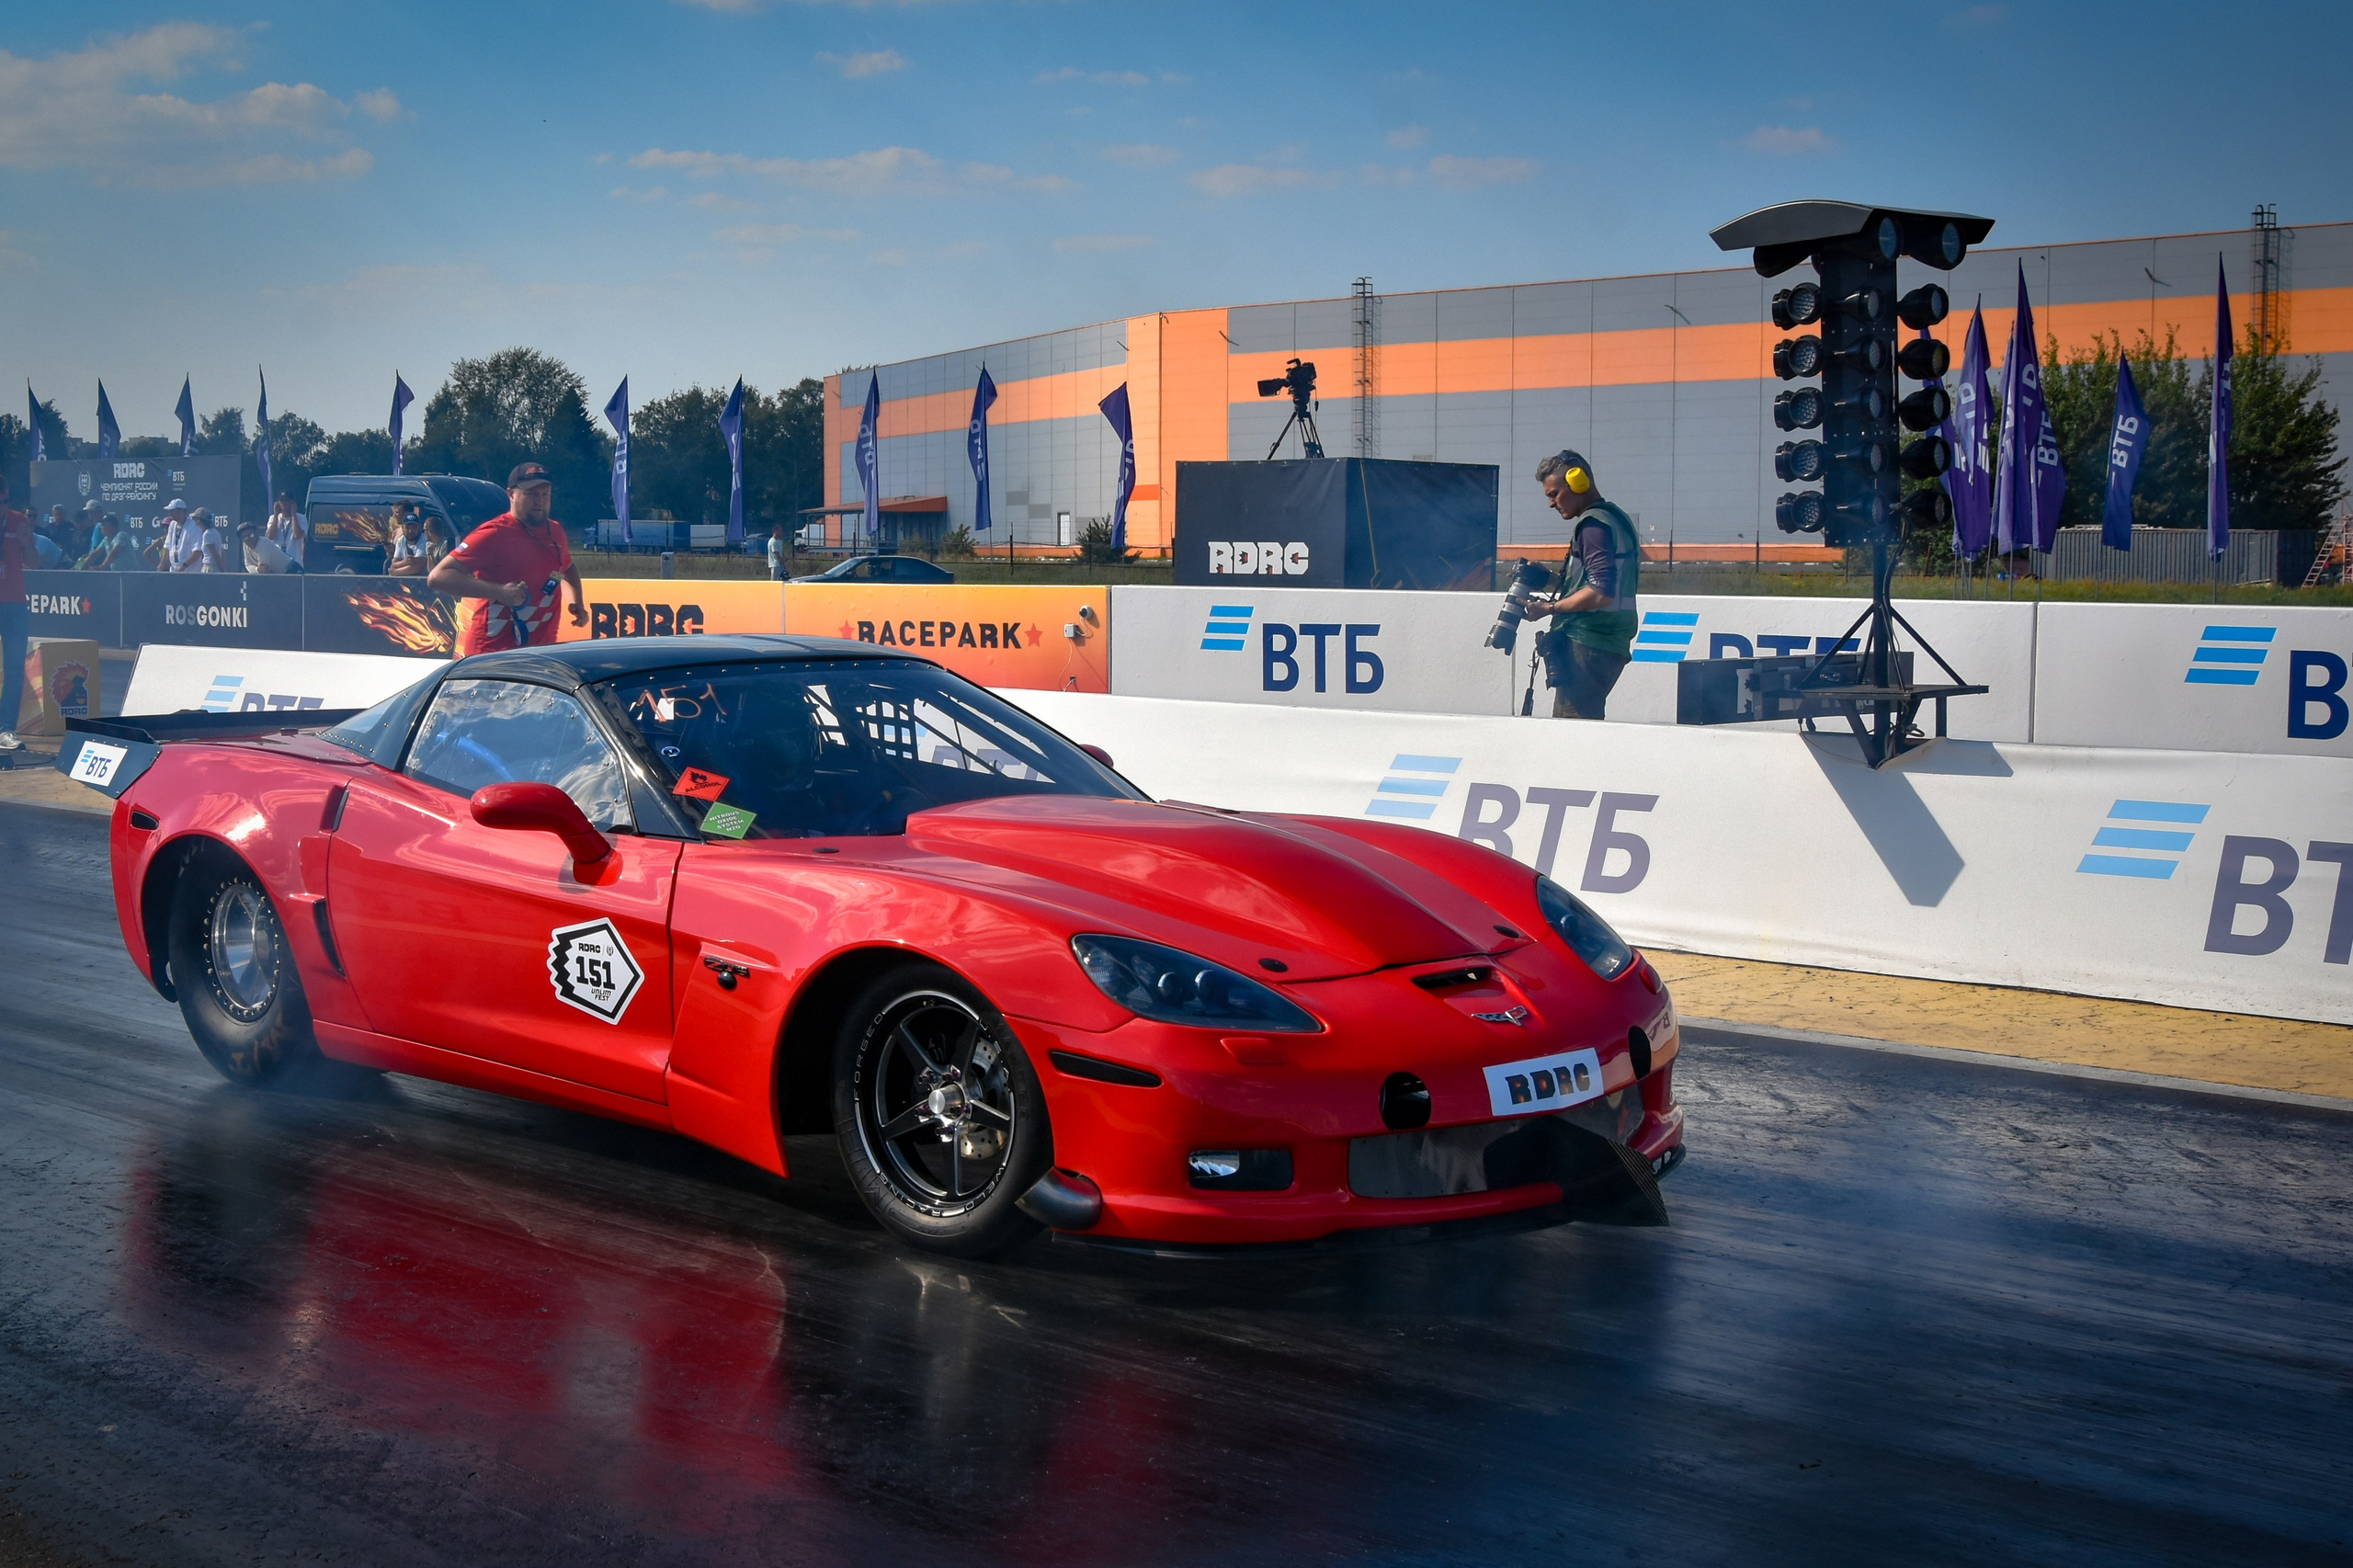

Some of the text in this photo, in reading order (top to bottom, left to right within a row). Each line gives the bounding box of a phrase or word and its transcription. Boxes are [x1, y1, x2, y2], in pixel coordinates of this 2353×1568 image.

[2112, 415, 2139, 469] ВТБ
[113, 462, 145, 478] RDRC
[172, 472, 185, 482] ВТБ
[102, 493, 110, 501] ПО
[130, 517, 143, 528] ВТБ
[214, 516, 228, 528] ВТБ
[314, 523, 339, 535] RDRC
[1209, 541, 1309, 574] RDRC
[165, 604, 247, 628] ROSGONKI
[589, 603, 704, 639] RDRC
[857, 620, 1022, 649] RACEPARK
[1262, 623, 1385, 695] ВТБ
[636, 683, 727, 722] 151
[2287, 650, 2353, 740] В
[61, 707, 88, 716] RDRC
[85, 756, 111, 778] ВТБ
[685, 781, 722, 793] ALCOHOL
[709, 811, 740, 822] NITROUS
[717, 816, 738, 824] OXIDE
[717, 819, 745, 829] SYSTEM
[1459, 782, 1660, 894] ВТБ
[578, 943, 601, 953] RDRC
[575, 956, 616, 990] 151
[854, 1013, 883, 1101] FORGED
[1505, 1062, 1591, 1106] RDRC
[879, 1172, 941, 1217] RACING
[965, 1167, 1005, 1210] WELD
